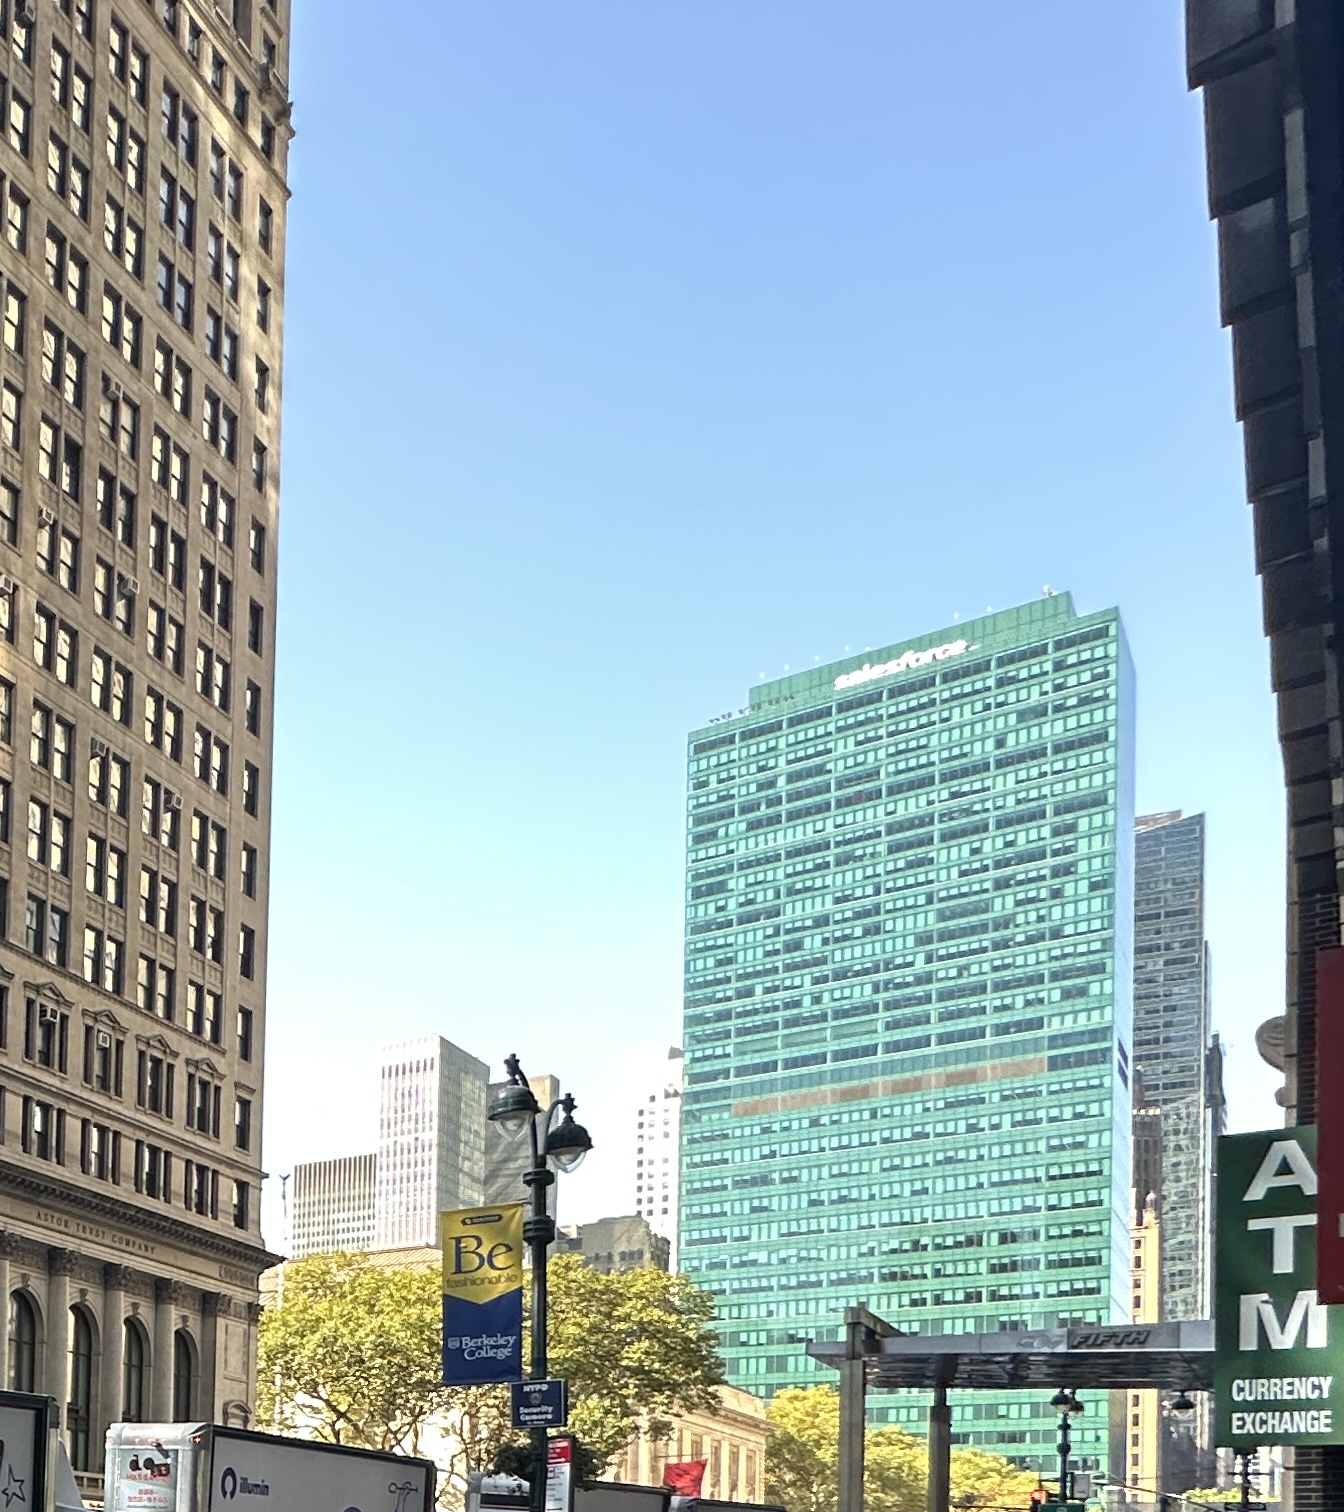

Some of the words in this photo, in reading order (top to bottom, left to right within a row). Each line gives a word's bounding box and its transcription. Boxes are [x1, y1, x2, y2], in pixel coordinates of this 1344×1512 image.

[112, 1233, 156, 1254] COMPANY
[448, 1235, 515, 1275] Be
[446, 1272, 518, 1288] fashionable
[462, 1333, 517, 1349] Berkeley
[1072, 1330, 1151, 1347] FIFTH
[464, 1346, 512, 1361] College
[1232, 1377, 1334, 1402] CURRENCY
[1232, 1409, 1334, 1435] EXCHANGE
[239, 1477, 269, 1496] illumin
